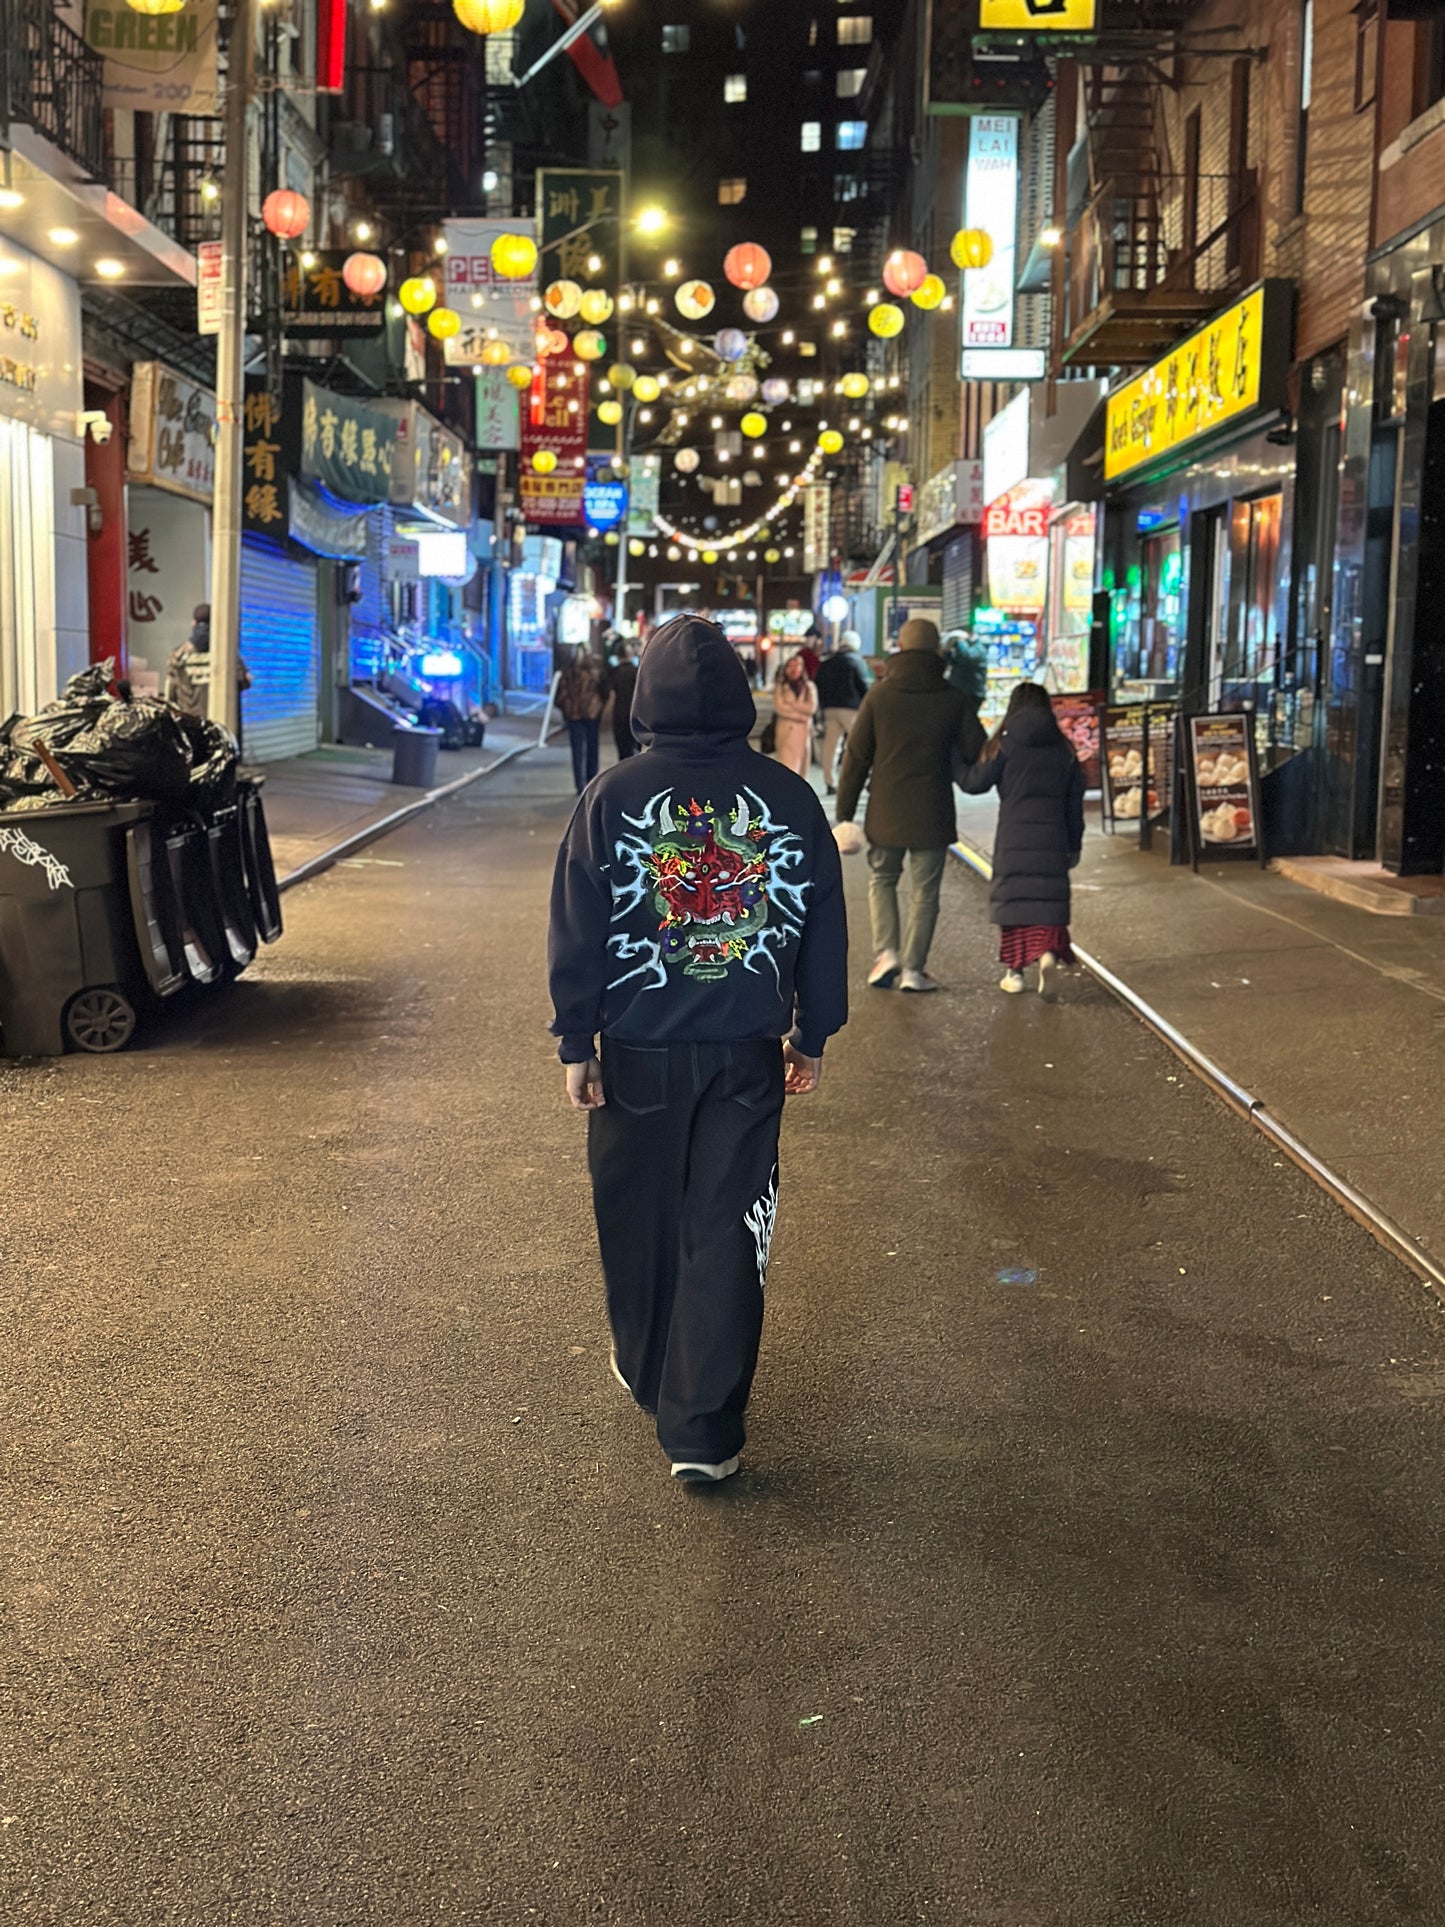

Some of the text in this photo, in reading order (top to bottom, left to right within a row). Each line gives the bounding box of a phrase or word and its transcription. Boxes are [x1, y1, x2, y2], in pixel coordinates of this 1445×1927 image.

[90, 9, 197, 52] GREEN
[152, 82, 192, 100] 200
[977, 120, 1011, 132] MEI
[978, 139, 1009, 151] LAI
[245, 392, 283, 523] 佛有緣
[584, 486, 623, 499] OCEAN
[987, 510, 1043, 534] BAR
